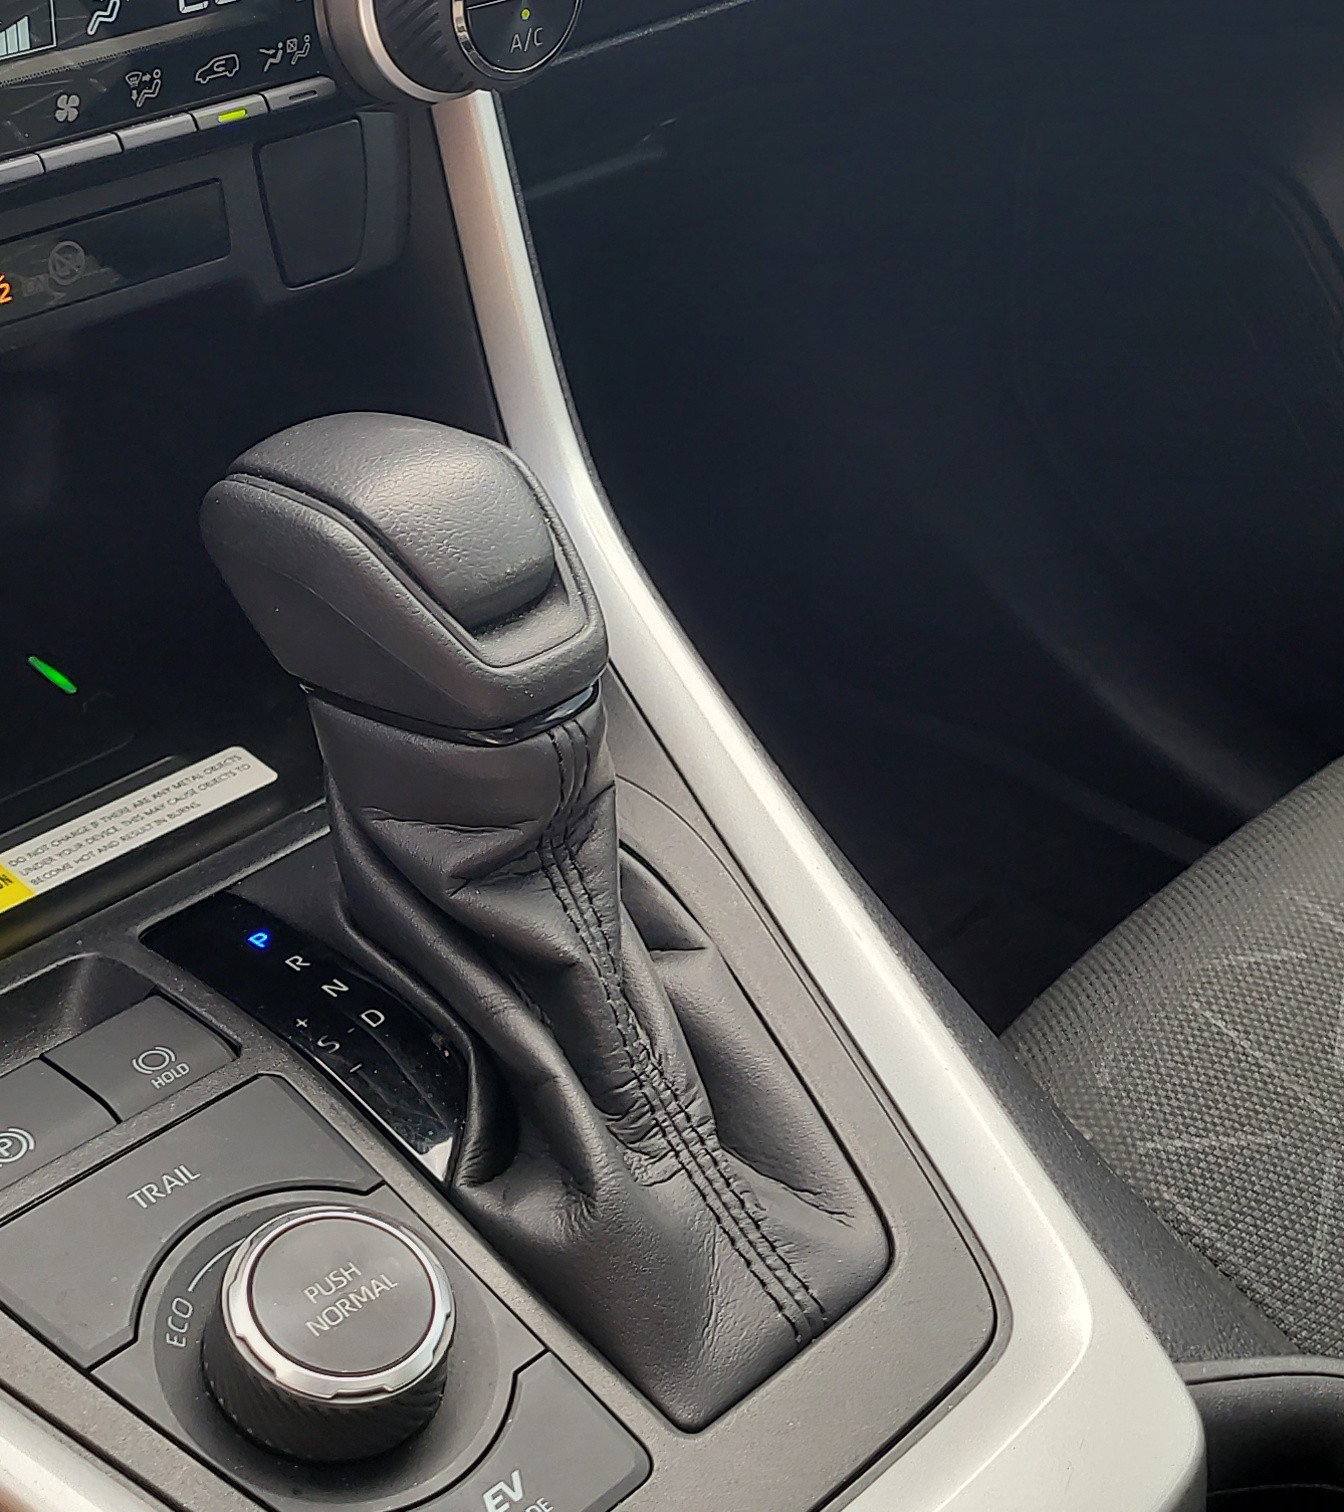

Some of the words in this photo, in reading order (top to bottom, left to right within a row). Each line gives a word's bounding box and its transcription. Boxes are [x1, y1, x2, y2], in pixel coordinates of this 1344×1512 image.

[509, 26, 544, 54] A/C
[8, 856, 27, 867] DO
[27, 844, 49, 858] NOT
[51, 825, 89, 847] CHARGE
[172, 774, 204, 790] METAL
[203, 754, 242, 775] OBJECTS
[19, 856, 56, 877] UNDER
[56, 842, 84, 858] YOUR
[167, 788, 198, 806] CAUSE
[197, 770, 238, 791] OBJECTS
[30, 862, 73, 885] BECOME
[73, 850, 96, 864] HOT
[97, 840, 120, 854] AND
[247, 931, 268, 949] P
[285, 955, 311, 972] R
[321, 978, 349, 998] N
[360, 1009, 386, 1028] D
[316, 1035, 341, 1054] S
[150, 1062, 191, 1090] HOLD
[126, 1164, 202, 1210] TRAIL
[303, 1261, 363, 1306] PUSH
[305, 1271, 399, 1338] NORMAL
[165, 1296, 194, 1349] ECO
[482, 1468, 524, 1512] EV
